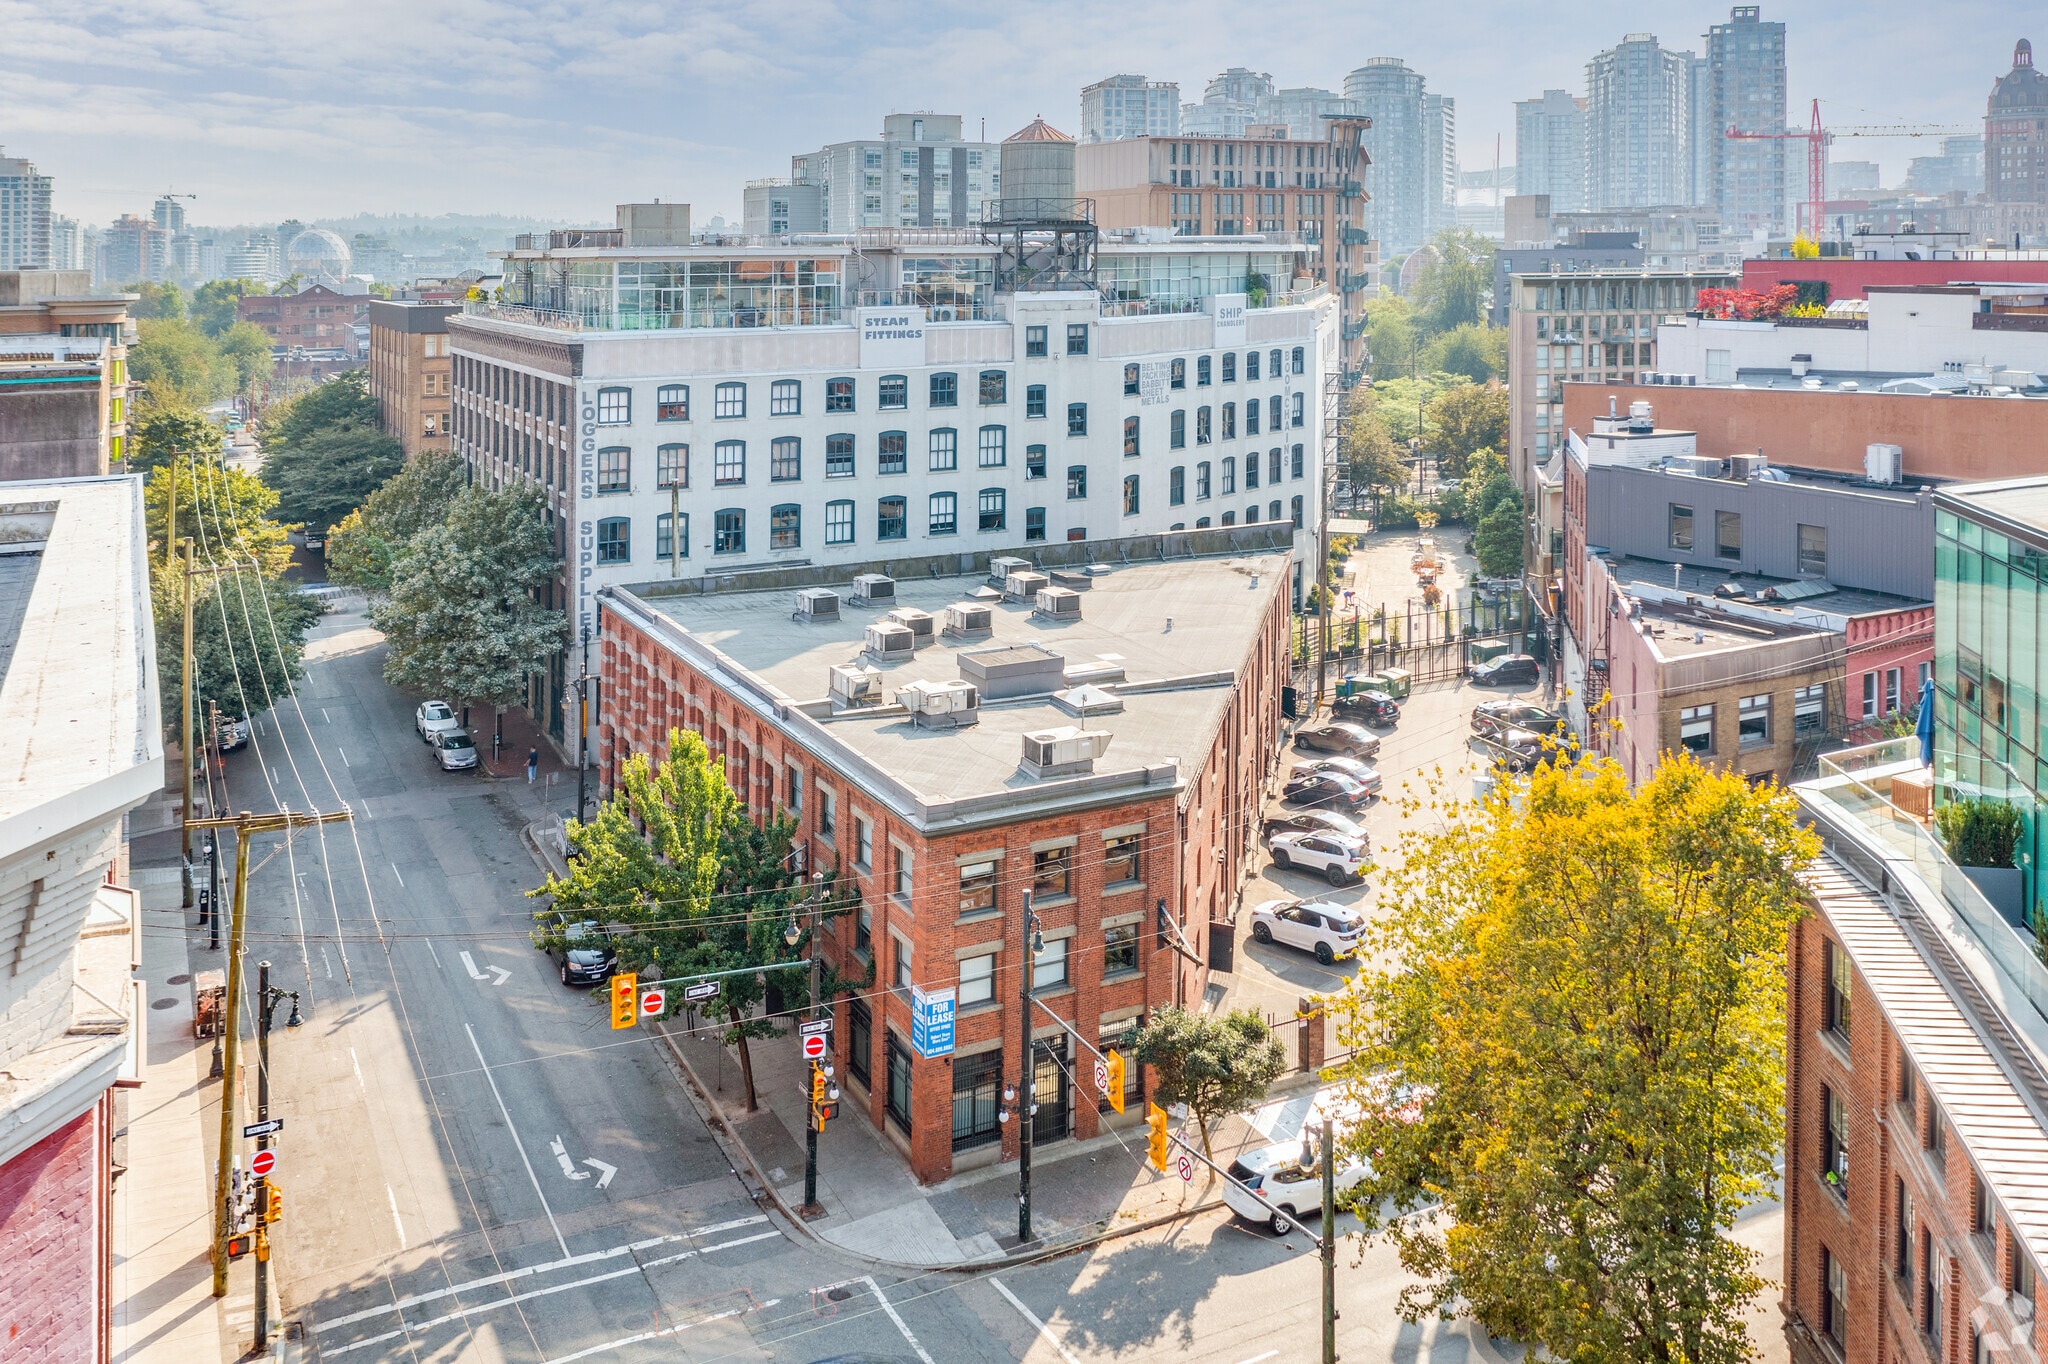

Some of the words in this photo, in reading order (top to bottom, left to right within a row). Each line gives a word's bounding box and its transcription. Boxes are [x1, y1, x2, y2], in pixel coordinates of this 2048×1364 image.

[1220, 307, 1242, 319] SHIP
[865, 317, 909, 327] STEAM
[1216, 319, 1245, 328] CHANDLERY
[865, 329, 923, 340] FITTINGS
[1141, 361, 1171, 372] BELTING
[1141, 370, 1171, 380] PACKING
[1141, 378, 1171, 389] BABBITT
[1141, 387, 1164, 398] SHEET
[1141, 395, 1170, 407] METALS
[581, 391, 596, 500] LOGGERS
[580, 520, 594, 643] SUPPLIES
[914, 997, 923, 1013] FOR
[932, 1002, 949, 1015] FOR
[912, 1005, 925, 1026] LEASE
[927, 1011, 954, 1027] LEASE
